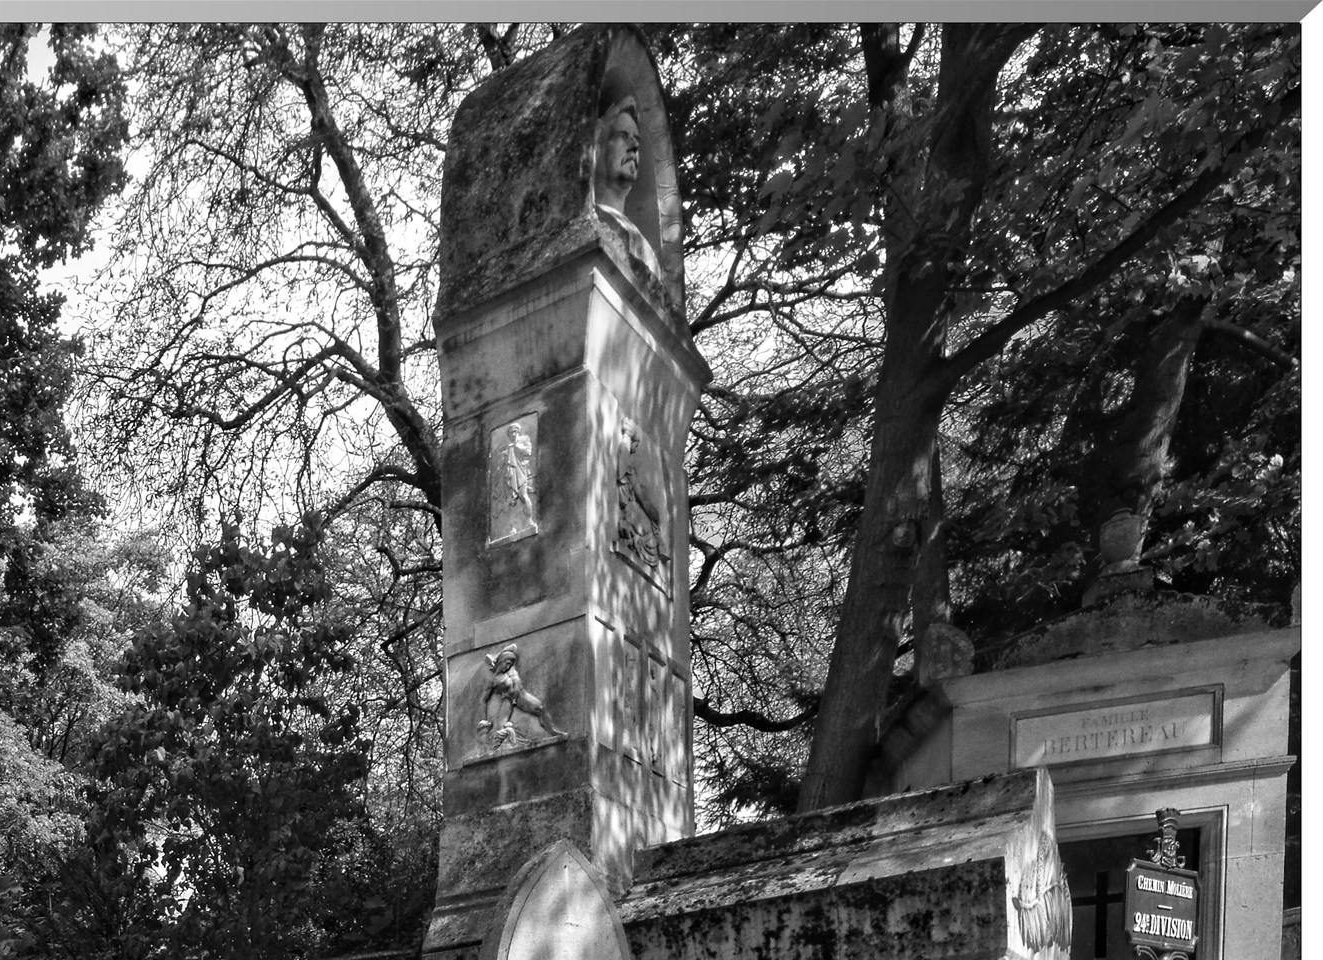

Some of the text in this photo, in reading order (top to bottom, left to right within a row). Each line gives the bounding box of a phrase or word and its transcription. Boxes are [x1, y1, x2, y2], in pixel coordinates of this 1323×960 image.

[1081, 709, 1149, 728] FAMILLE
[1043, 722, 1185, 755] BERTEREAU
[1137, 875, 1165, 893] CHEMIN
[1149, 914, 1193, 940] DIVISION
